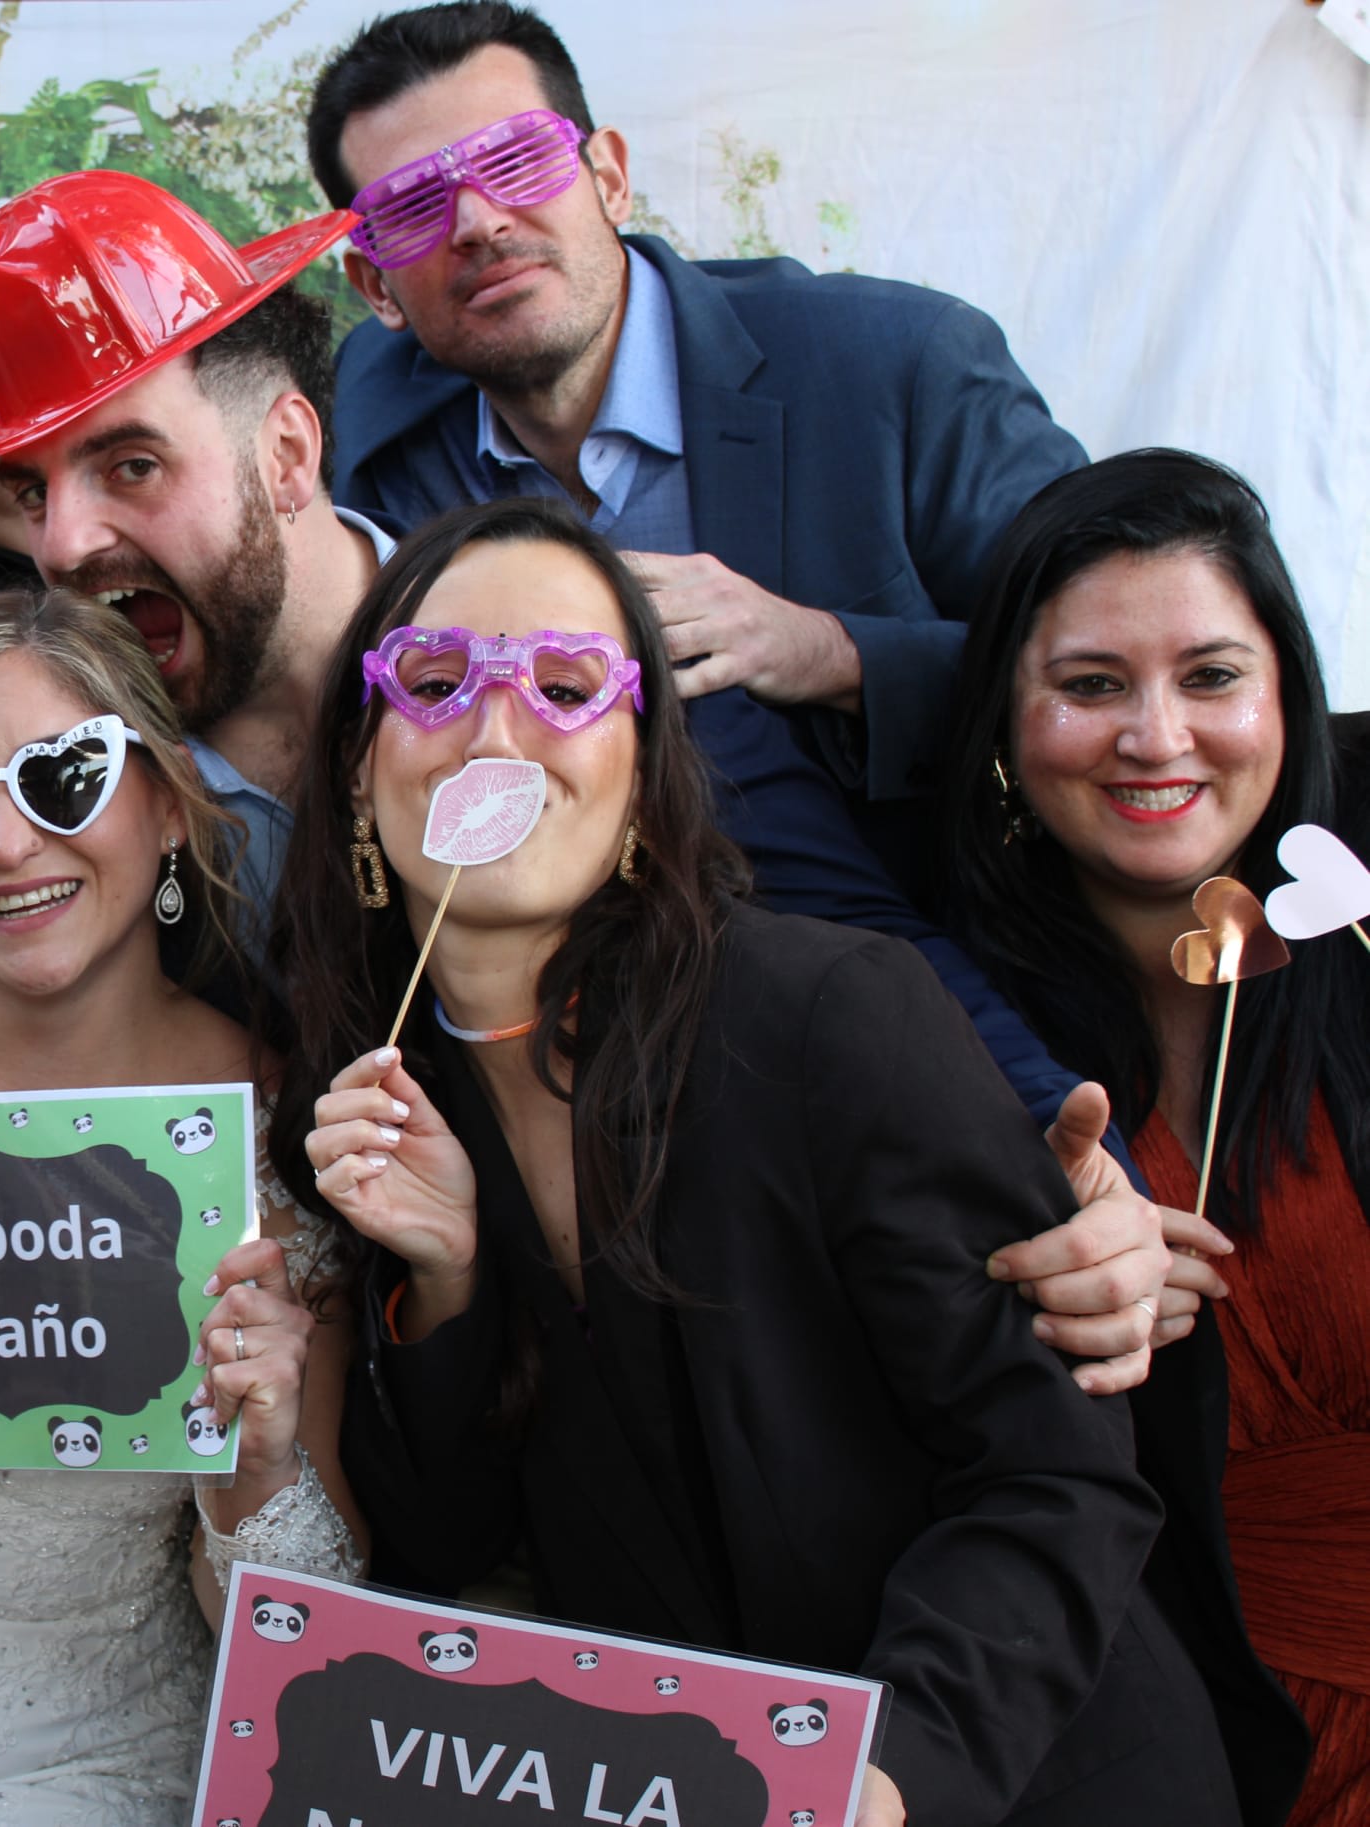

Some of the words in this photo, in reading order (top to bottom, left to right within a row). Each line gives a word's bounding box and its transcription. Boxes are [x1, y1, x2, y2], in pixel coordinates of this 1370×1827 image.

[25, 721, 103, 755] MARRIED
[370, 1719, 555, 1811] VIVA
[583, 1762, 681, 1827] LA
